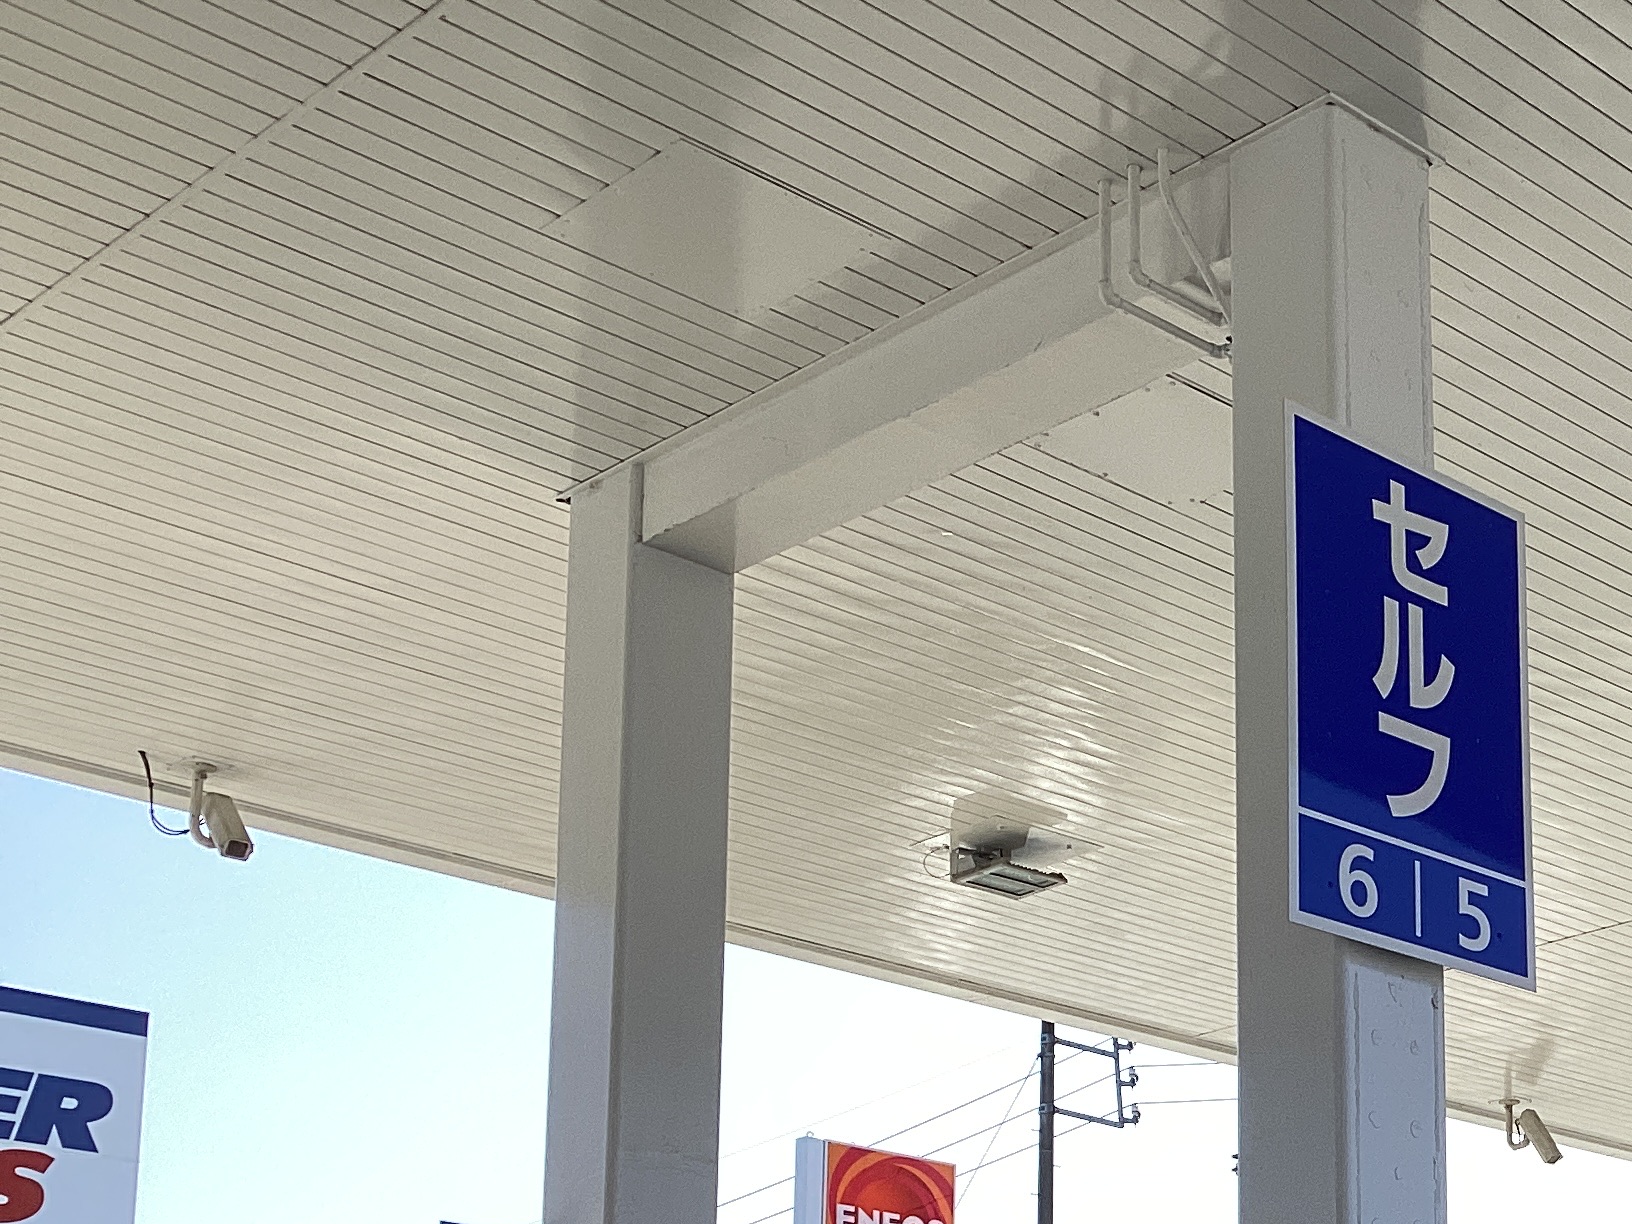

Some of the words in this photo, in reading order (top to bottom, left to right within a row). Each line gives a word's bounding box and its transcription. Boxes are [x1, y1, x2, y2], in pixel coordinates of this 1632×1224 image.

[1371, 478, 1455, 818] セルフ
[1338, 843, 1379, 919] 6
[1458, 877, 1491, 953] 5
